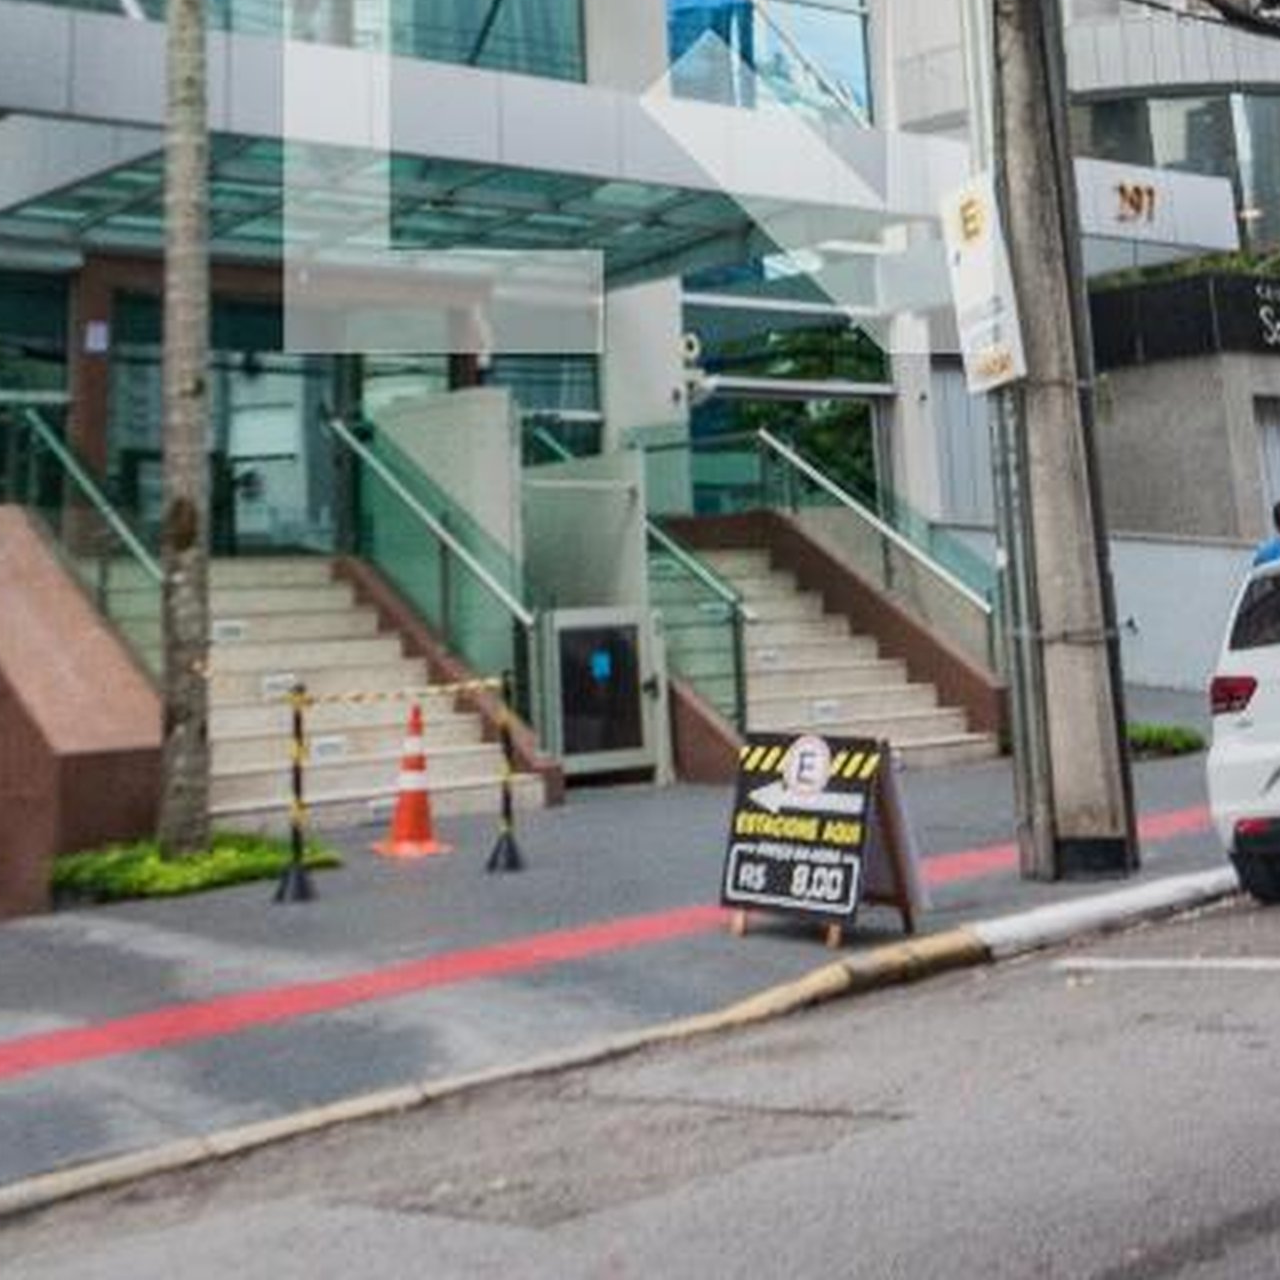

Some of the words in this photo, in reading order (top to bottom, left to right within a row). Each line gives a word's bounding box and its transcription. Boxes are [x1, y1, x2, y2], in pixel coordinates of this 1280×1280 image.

[959, 199, 982, 241] E
[797, 751, 816, 783] E
[739, 862, 767, 891] R$
